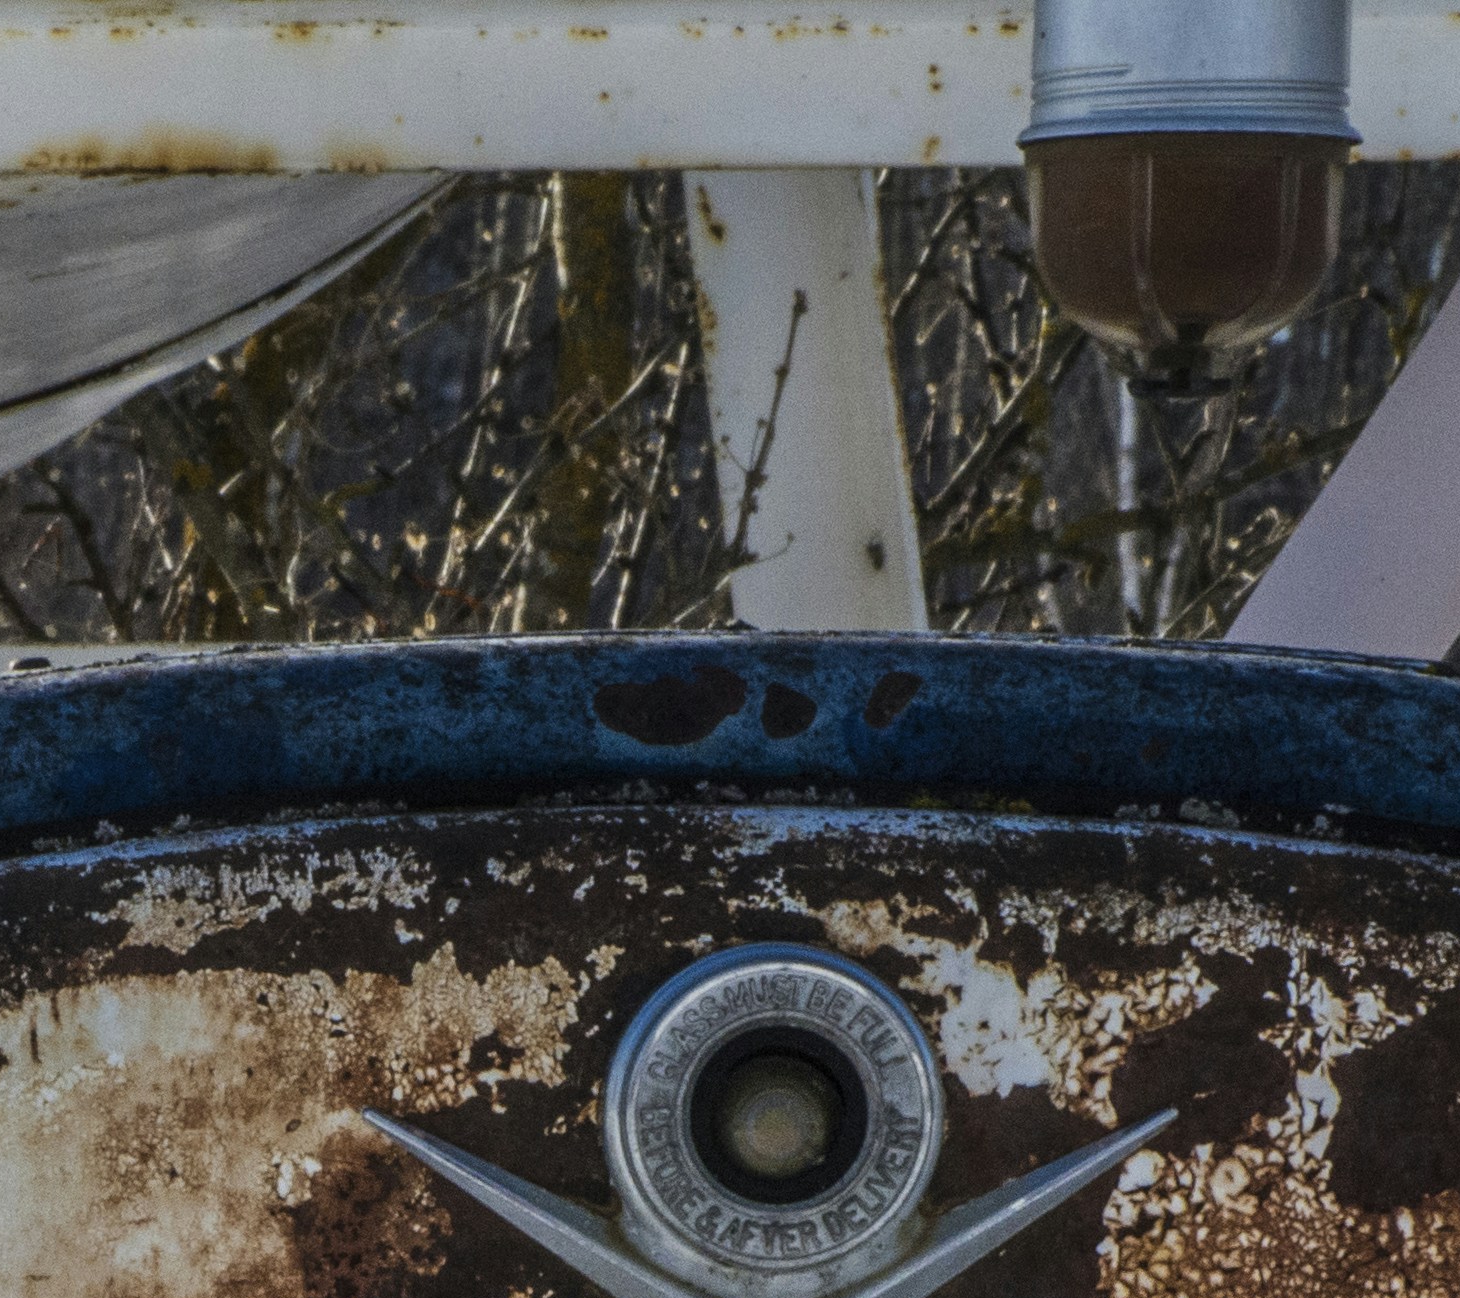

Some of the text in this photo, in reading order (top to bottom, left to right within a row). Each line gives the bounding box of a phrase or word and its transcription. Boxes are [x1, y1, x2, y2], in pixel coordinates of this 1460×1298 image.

[647, 974, 909, 1083] GLASS MUST BE FULL
[638, 1103, 923, 1253] BEFORE & AFTER DELIVERY
